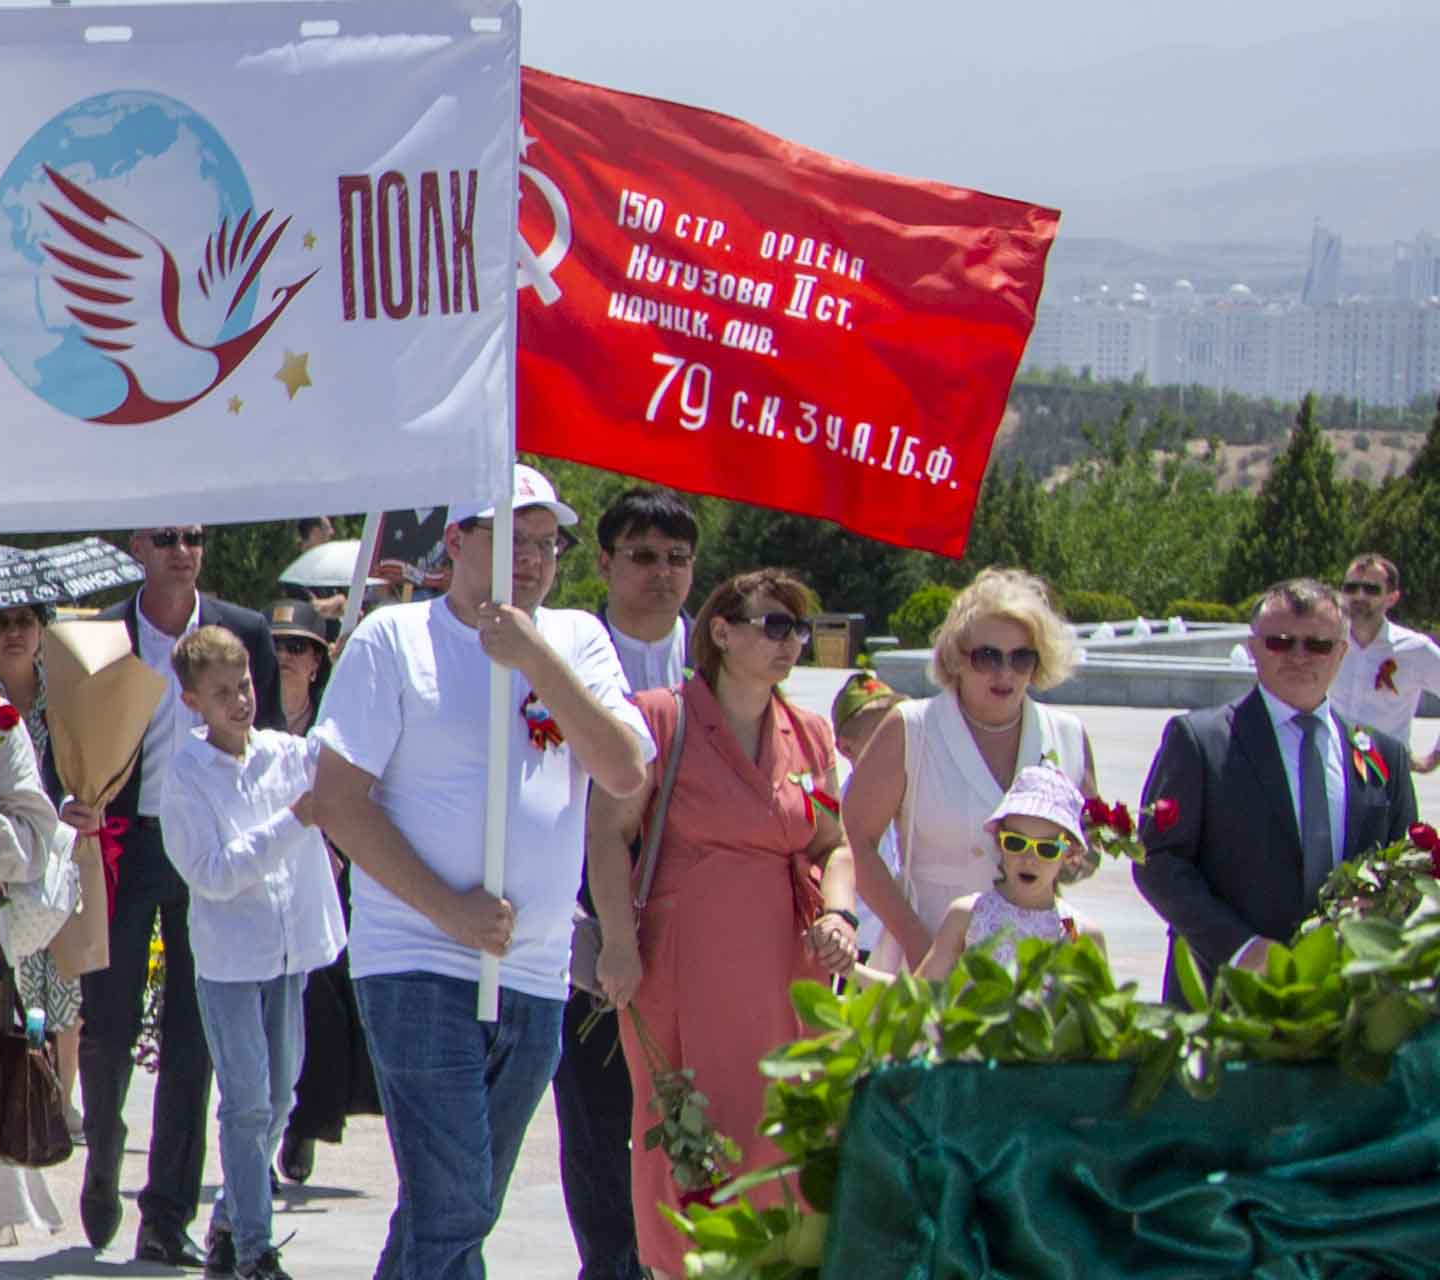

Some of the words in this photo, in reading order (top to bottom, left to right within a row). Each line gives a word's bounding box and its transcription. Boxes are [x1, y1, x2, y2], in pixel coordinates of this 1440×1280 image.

[338, 169, 479, 320] ПОЛК
[617, 188, 665, 235] 150
[645, 352, 713, 431] 79
